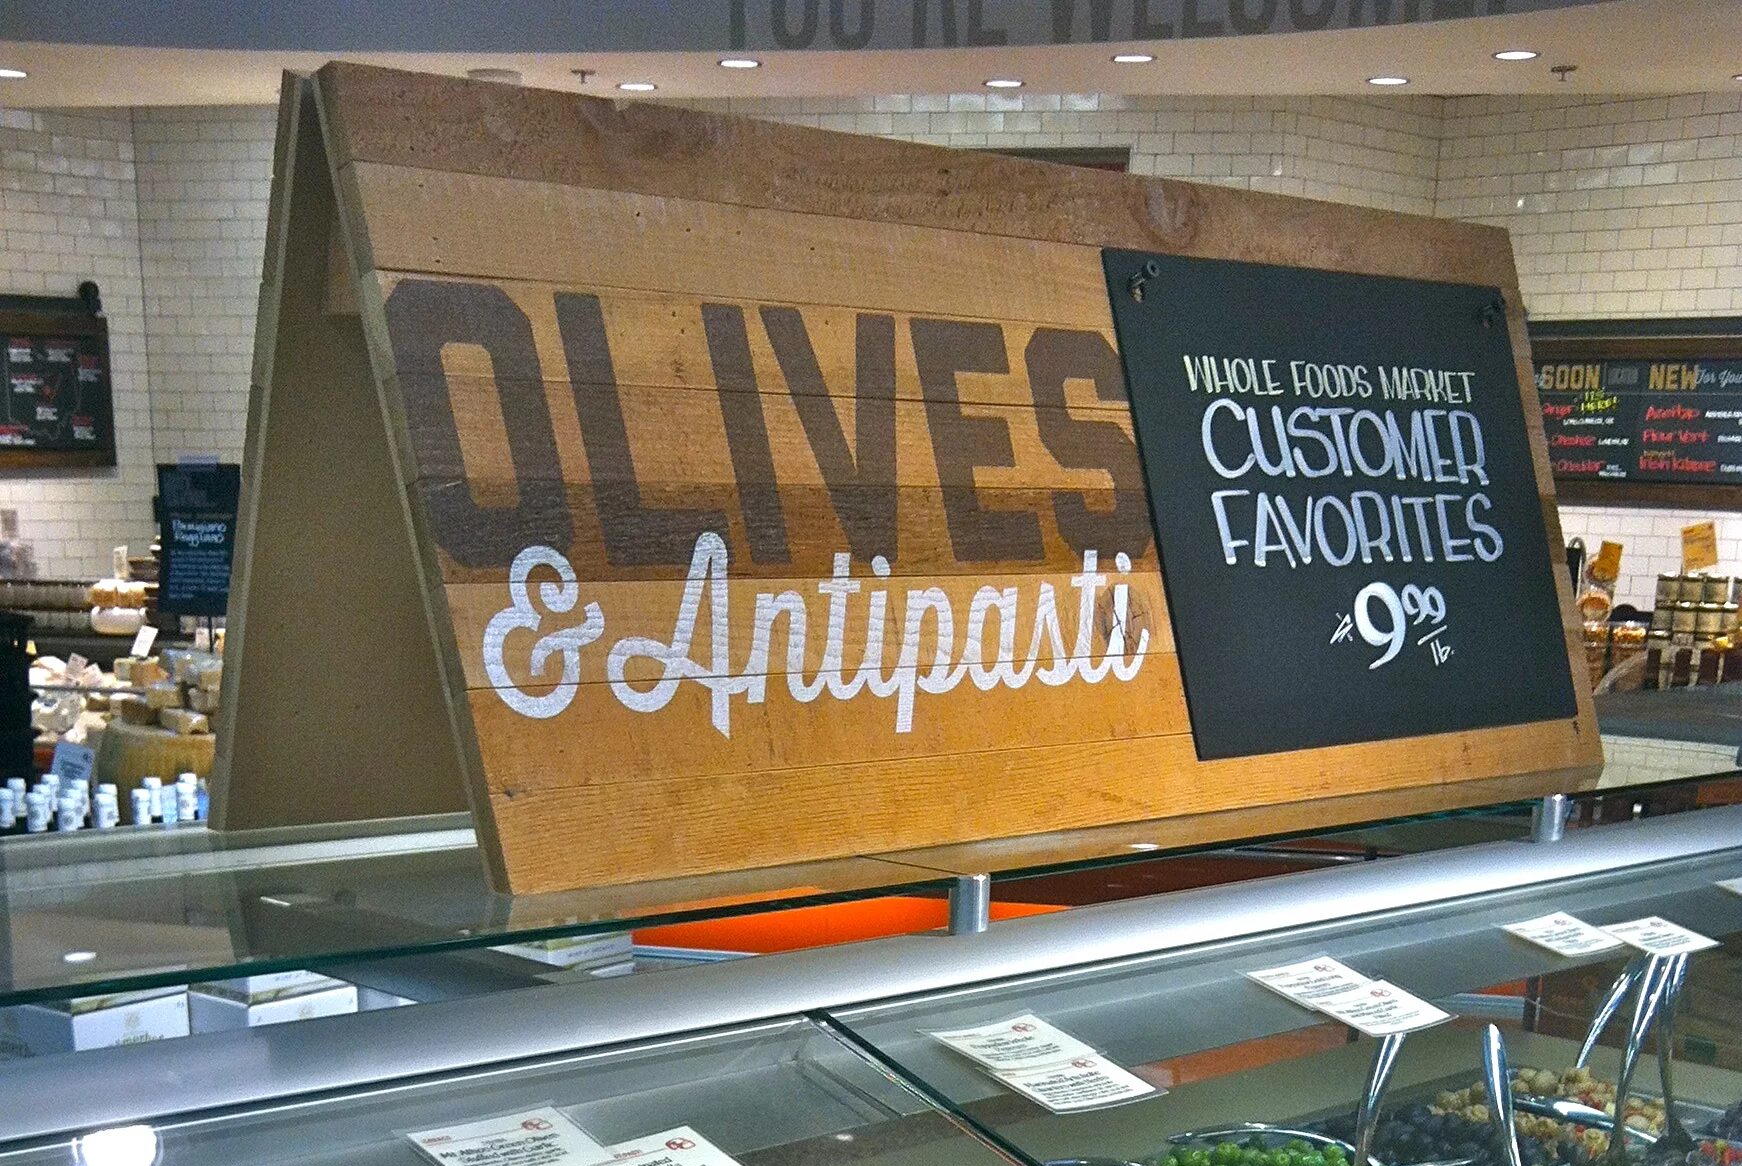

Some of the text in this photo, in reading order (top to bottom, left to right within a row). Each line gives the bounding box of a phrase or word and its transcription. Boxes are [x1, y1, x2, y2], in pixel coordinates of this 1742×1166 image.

[1183, 355, 1475, 404] WHOLE FOODS MARKET
[1541, 364, 1600, 390] SOON
[1648, 364, 1700, 390] NEW
[383, 278, 1157, 567] OLIVES
[1201, 398, 1490, 486] CUSTOMER
[1211, 489, 1504, 569] FAVORITES
[483, 531, 1150, 739] & Antipasti
